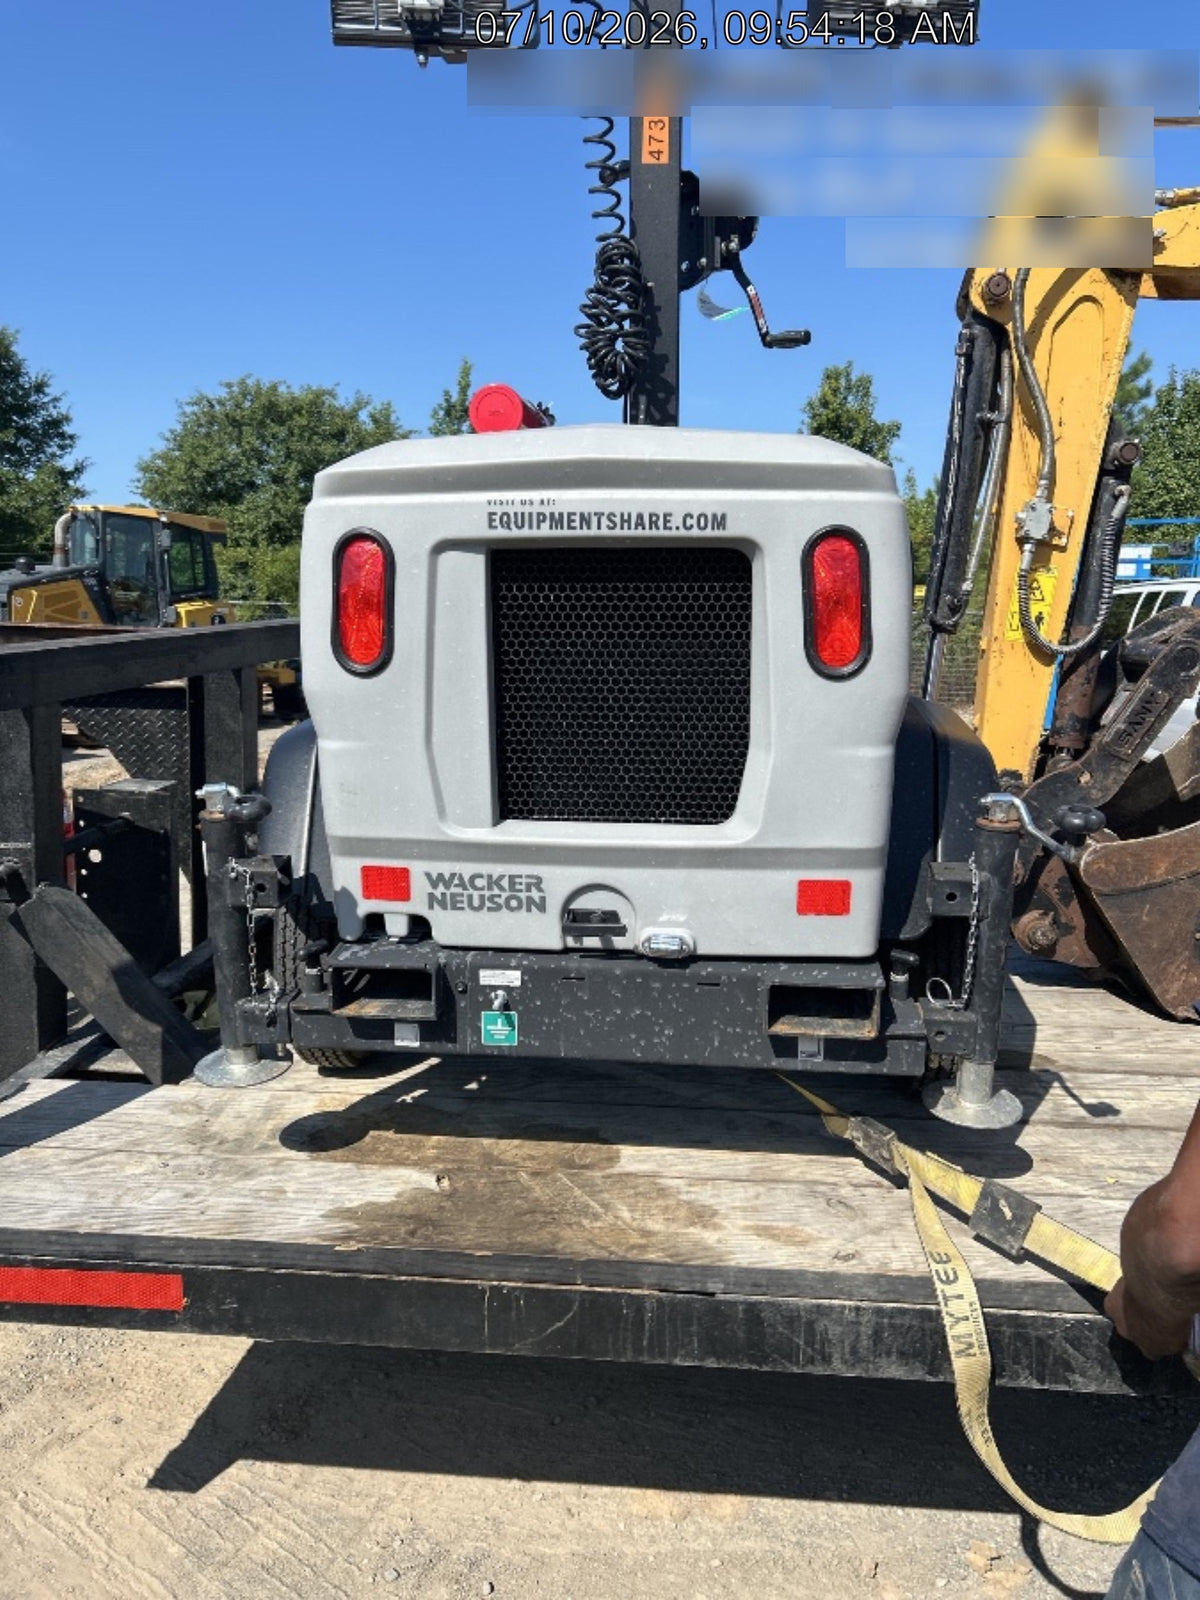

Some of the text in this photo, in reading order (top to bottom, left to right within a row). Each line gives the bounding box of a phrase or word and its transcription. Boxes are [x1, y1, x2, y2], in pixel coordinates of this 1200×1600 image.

[487, 511, 727, 532] EQUIPMENTSHARE.COM
[424, 871, 545, 893] WACKER
[427, 892, 547, 914] NEUSON
[928, 1250, 977, 1359] MYTEE
